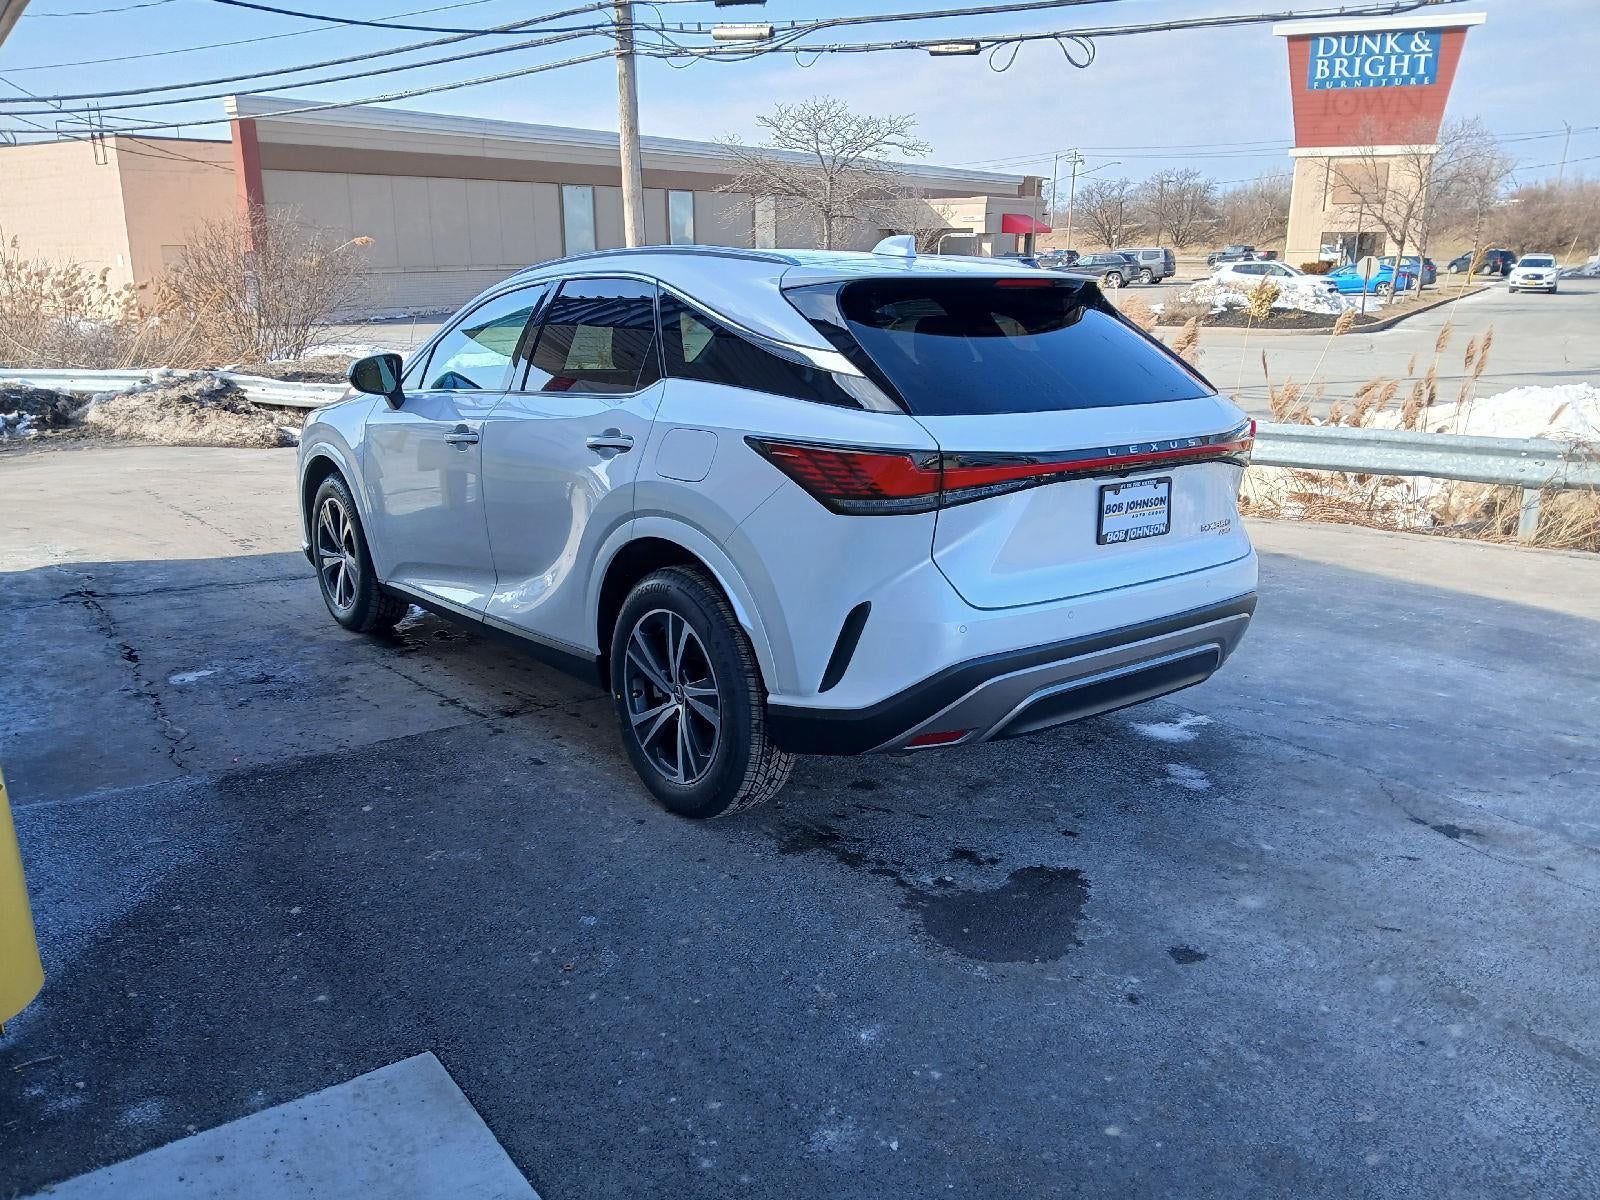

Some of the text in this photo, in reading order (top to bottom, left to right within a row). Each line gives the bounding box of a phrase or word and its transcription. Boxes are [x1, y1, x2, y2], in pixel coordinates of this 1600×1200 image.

[1317, 30, 1433, 58] DUNK &
[1315, 53, 1433, 80] BRIGHT
[1313, 76, 1431, 90] FURNITURE
[1107, 439, 1196, 456] LEXUS
[1105, 496, 1167, 515] BOB JOHNSON
[1106, 522, 1166, 543] BOB JOHNSON
